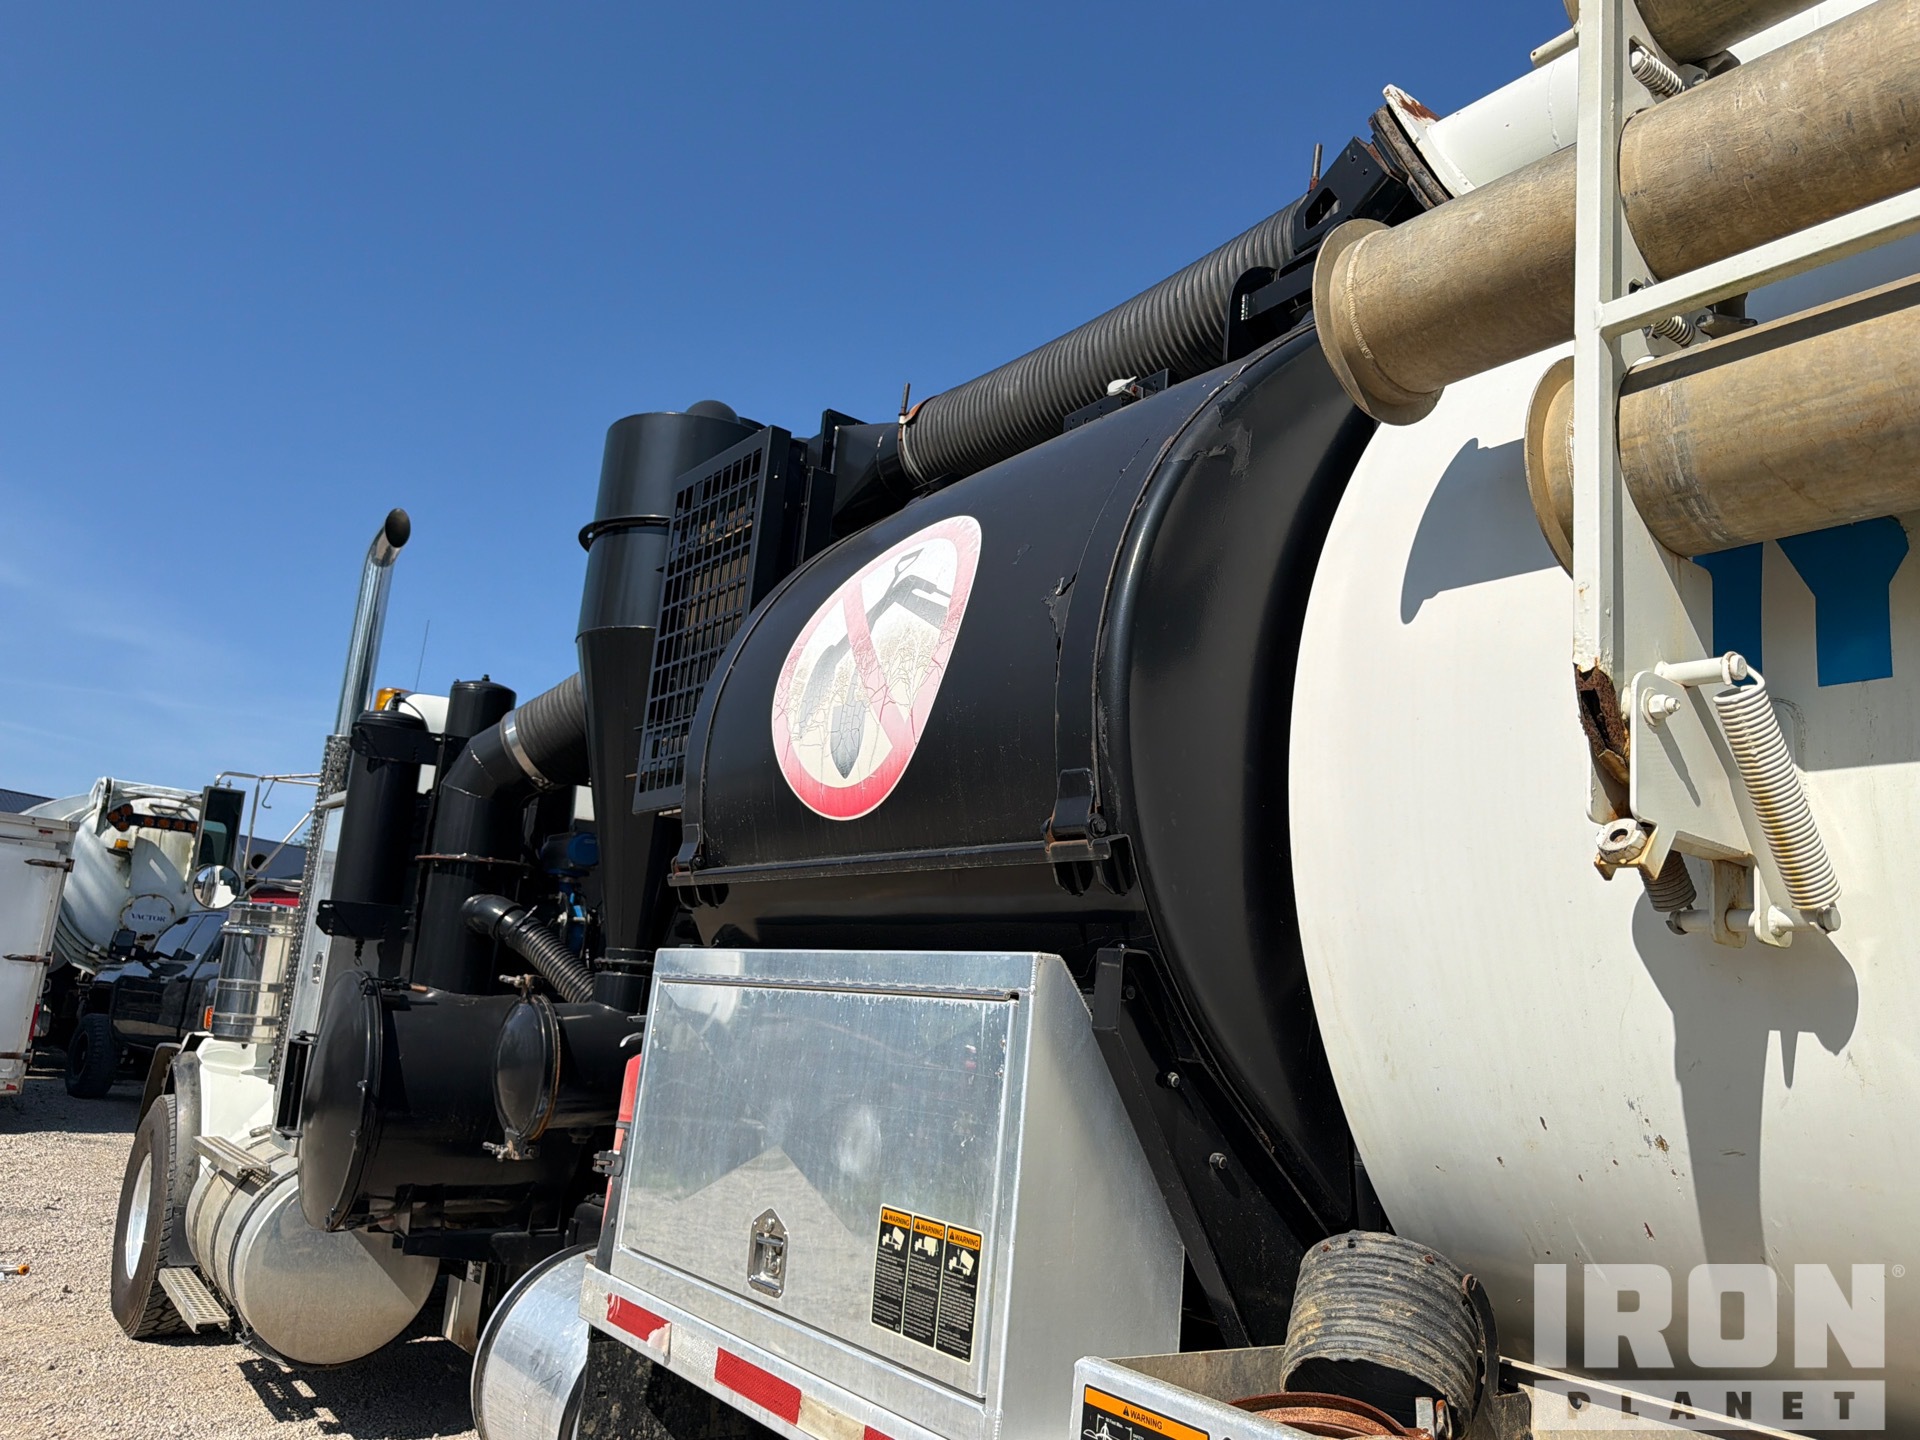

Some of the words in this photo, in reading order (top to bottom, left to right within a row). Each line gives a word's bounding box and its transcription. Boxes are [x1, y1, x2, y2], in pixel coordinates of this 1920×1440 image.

[131, 913, 167, 922] VACTOR
[888, 1214, 910, 1227] WARNING
[920, 1224, 943, 1237] WARNING
[954, 1234, 979, 1248] WARNING
[1130, 1409, 1163, 1430] WARNING
